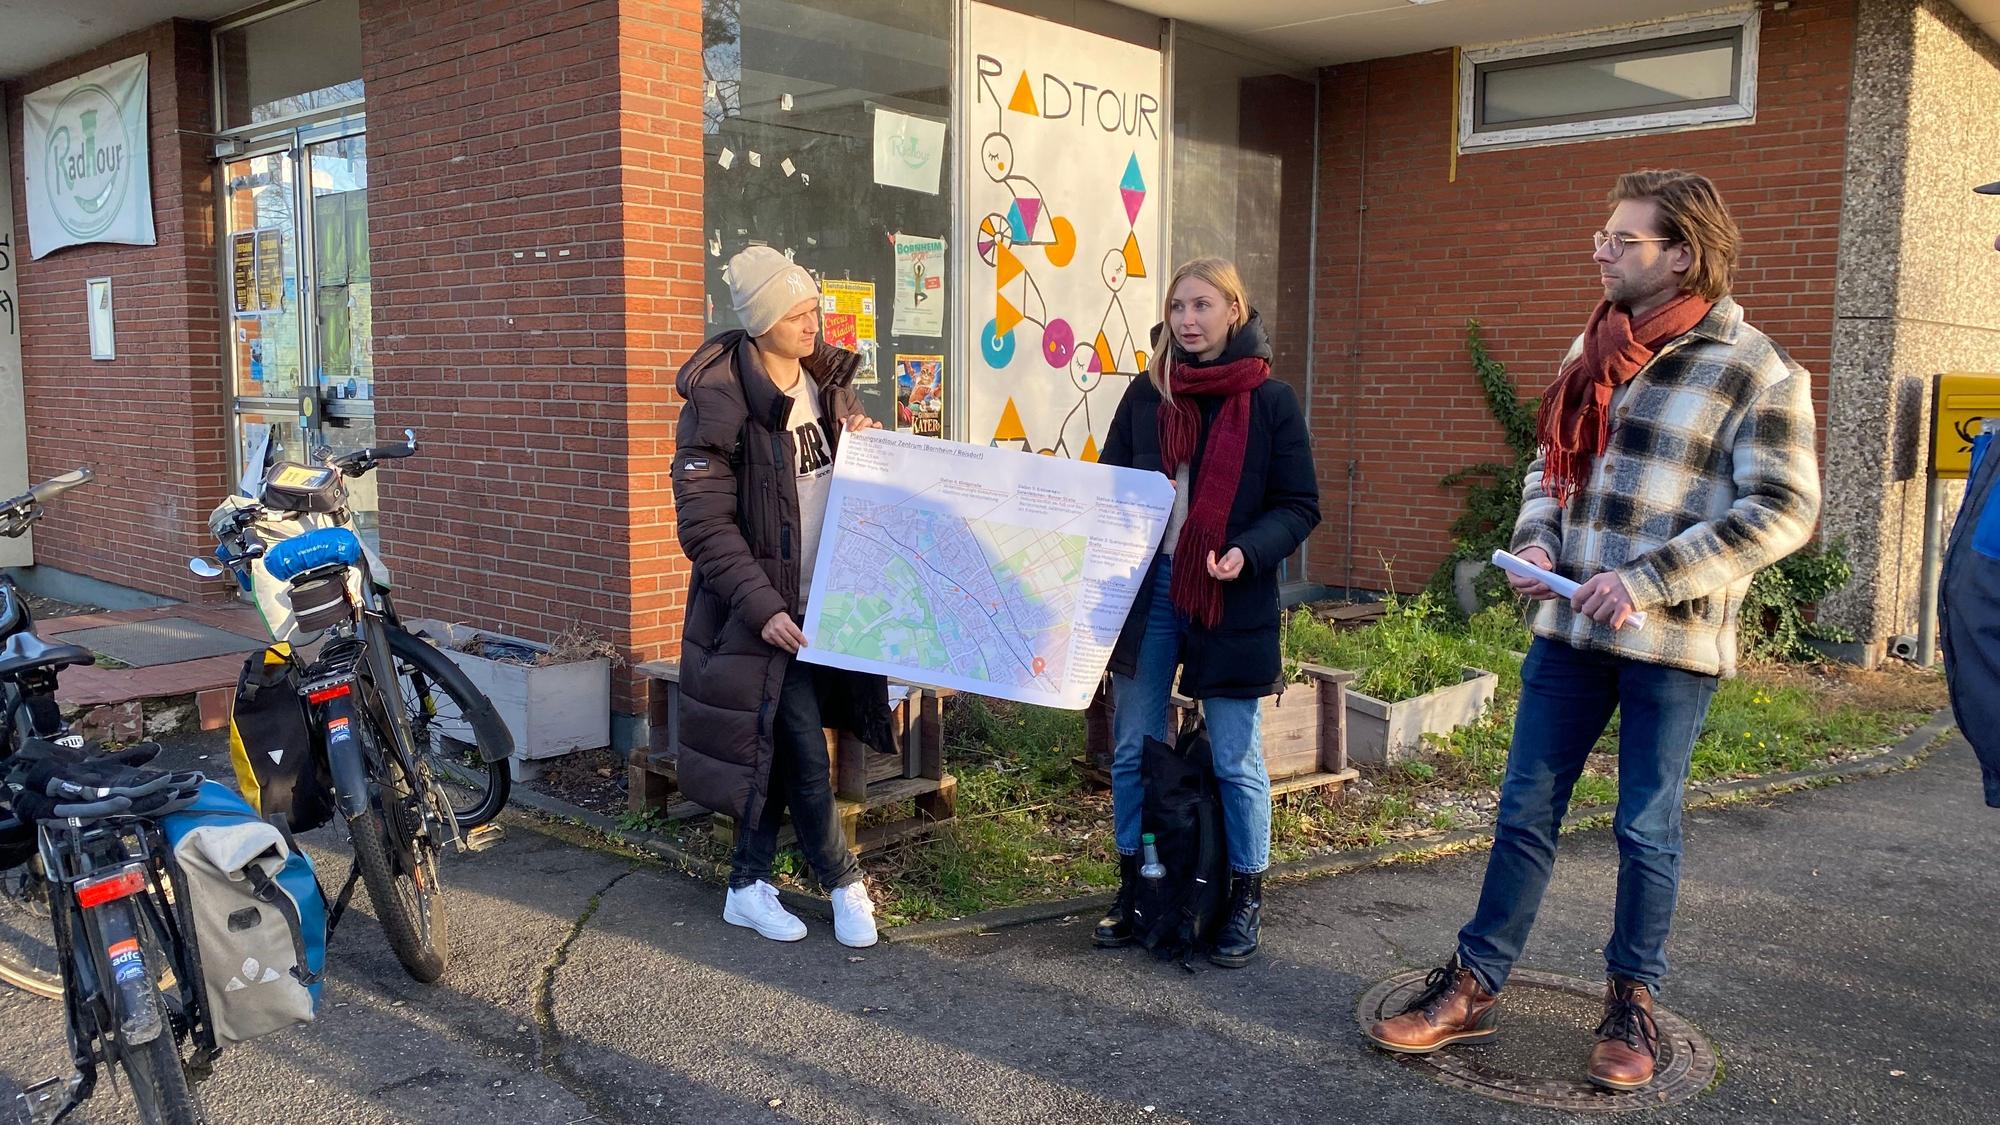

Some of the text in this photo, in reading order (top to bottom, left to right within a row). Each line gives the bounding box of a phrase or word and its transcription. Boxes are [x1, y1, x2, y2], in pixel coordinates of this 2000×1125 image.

[977, 54, 1158, 140] RADTOUR
[896, 242, 942, 254] BORNHEIM
[898, 440, 922, 450] Zentrum
[330, 724, 349, 734] adfc
[112, 951, 140, 967] adfc
